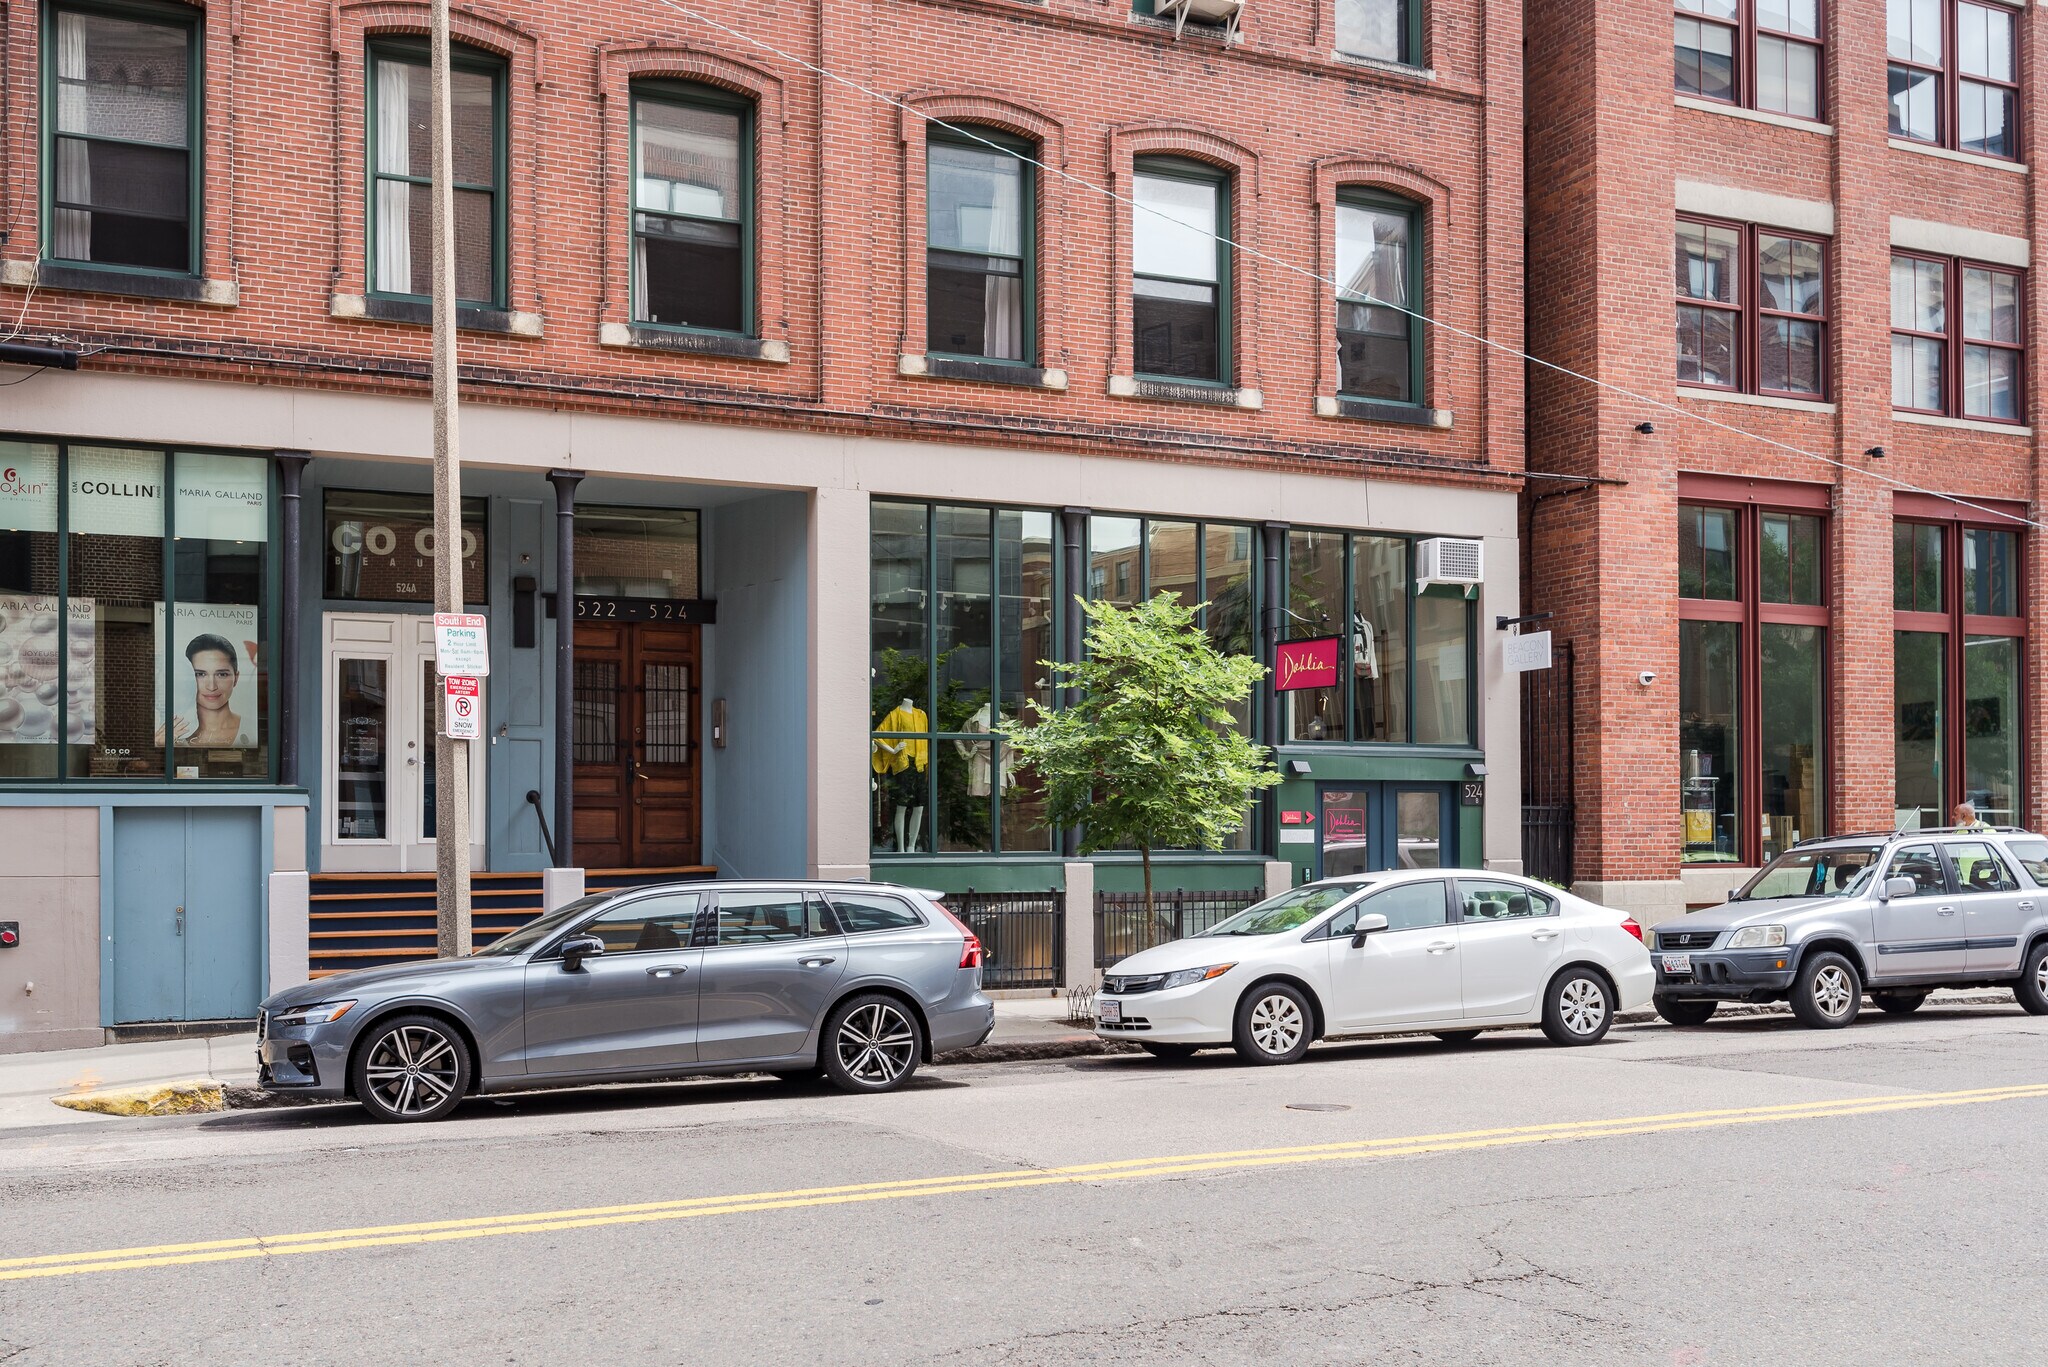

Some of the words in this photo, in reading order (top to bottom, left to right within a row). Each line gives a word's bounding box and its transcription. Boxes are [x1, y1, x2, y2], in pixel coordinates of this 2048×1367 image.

[179, 488, 211, 497] MARIA
[214, 490, 263, 500] GALLAND
[335, 556, 476, 569] BEAUY
[396, 583, 417, 593] 524A
[0, 602, 29, 611] ARIA
[33, 602, 91, 613] GALAND
[159, 607, 195, 617] MRIA
[199, 609, 254, 619] GALLAND
[578, 601, 616, 617] 522
[650, 604, 687, 619] 524
[466, 617, 481, 626] End
[447, 628, 476, 639] Parking
[1508, 639, 1544, 655] BEACON
[1508, 650, 1544, 666] GALLERY
[448, 677, 460, 685] TOW
[461, 679, 477, 687] ZONE
[1465, 784, 1483, 798] 524
